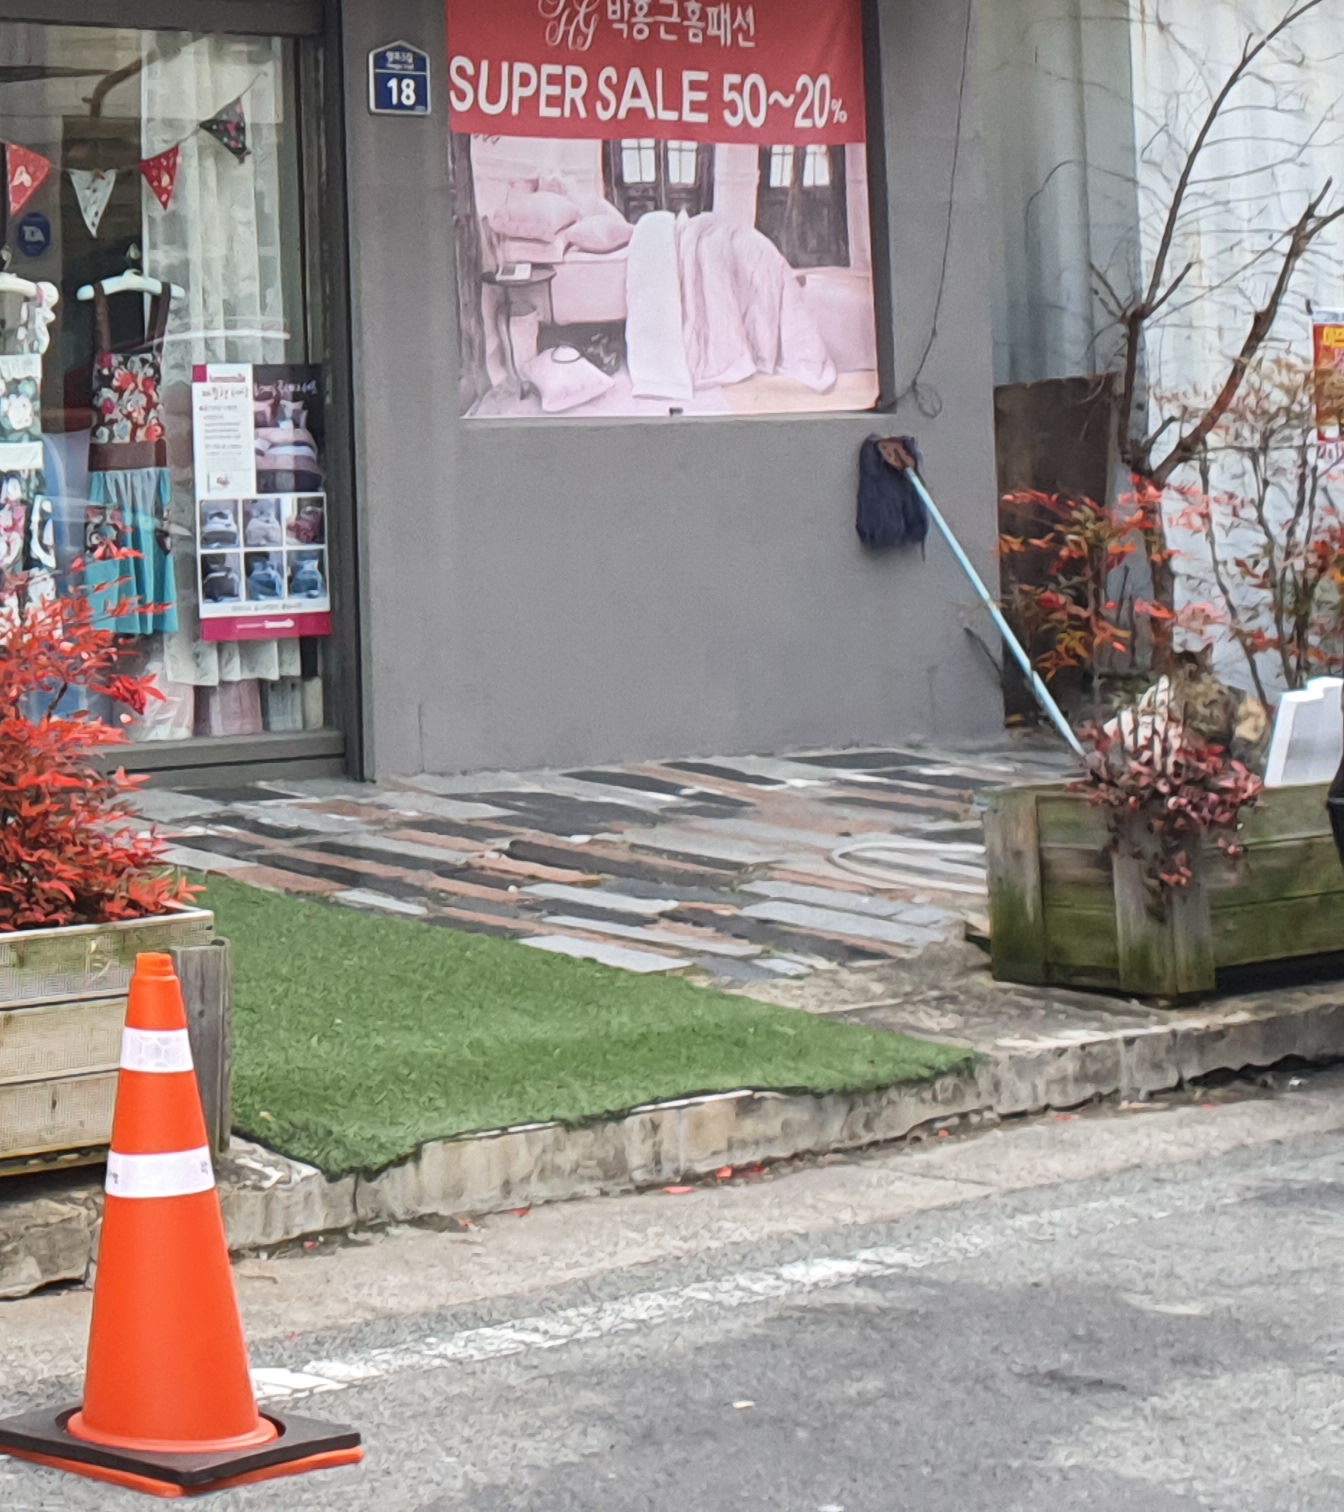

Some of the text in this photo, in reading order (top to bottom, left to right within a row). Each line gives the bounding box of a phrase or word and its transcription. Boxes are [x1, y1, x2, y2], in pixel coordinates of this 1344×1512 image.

[386, 76, 416, 106] 18
[448, 55, 848, 129] SUPER SALE 50~20%
